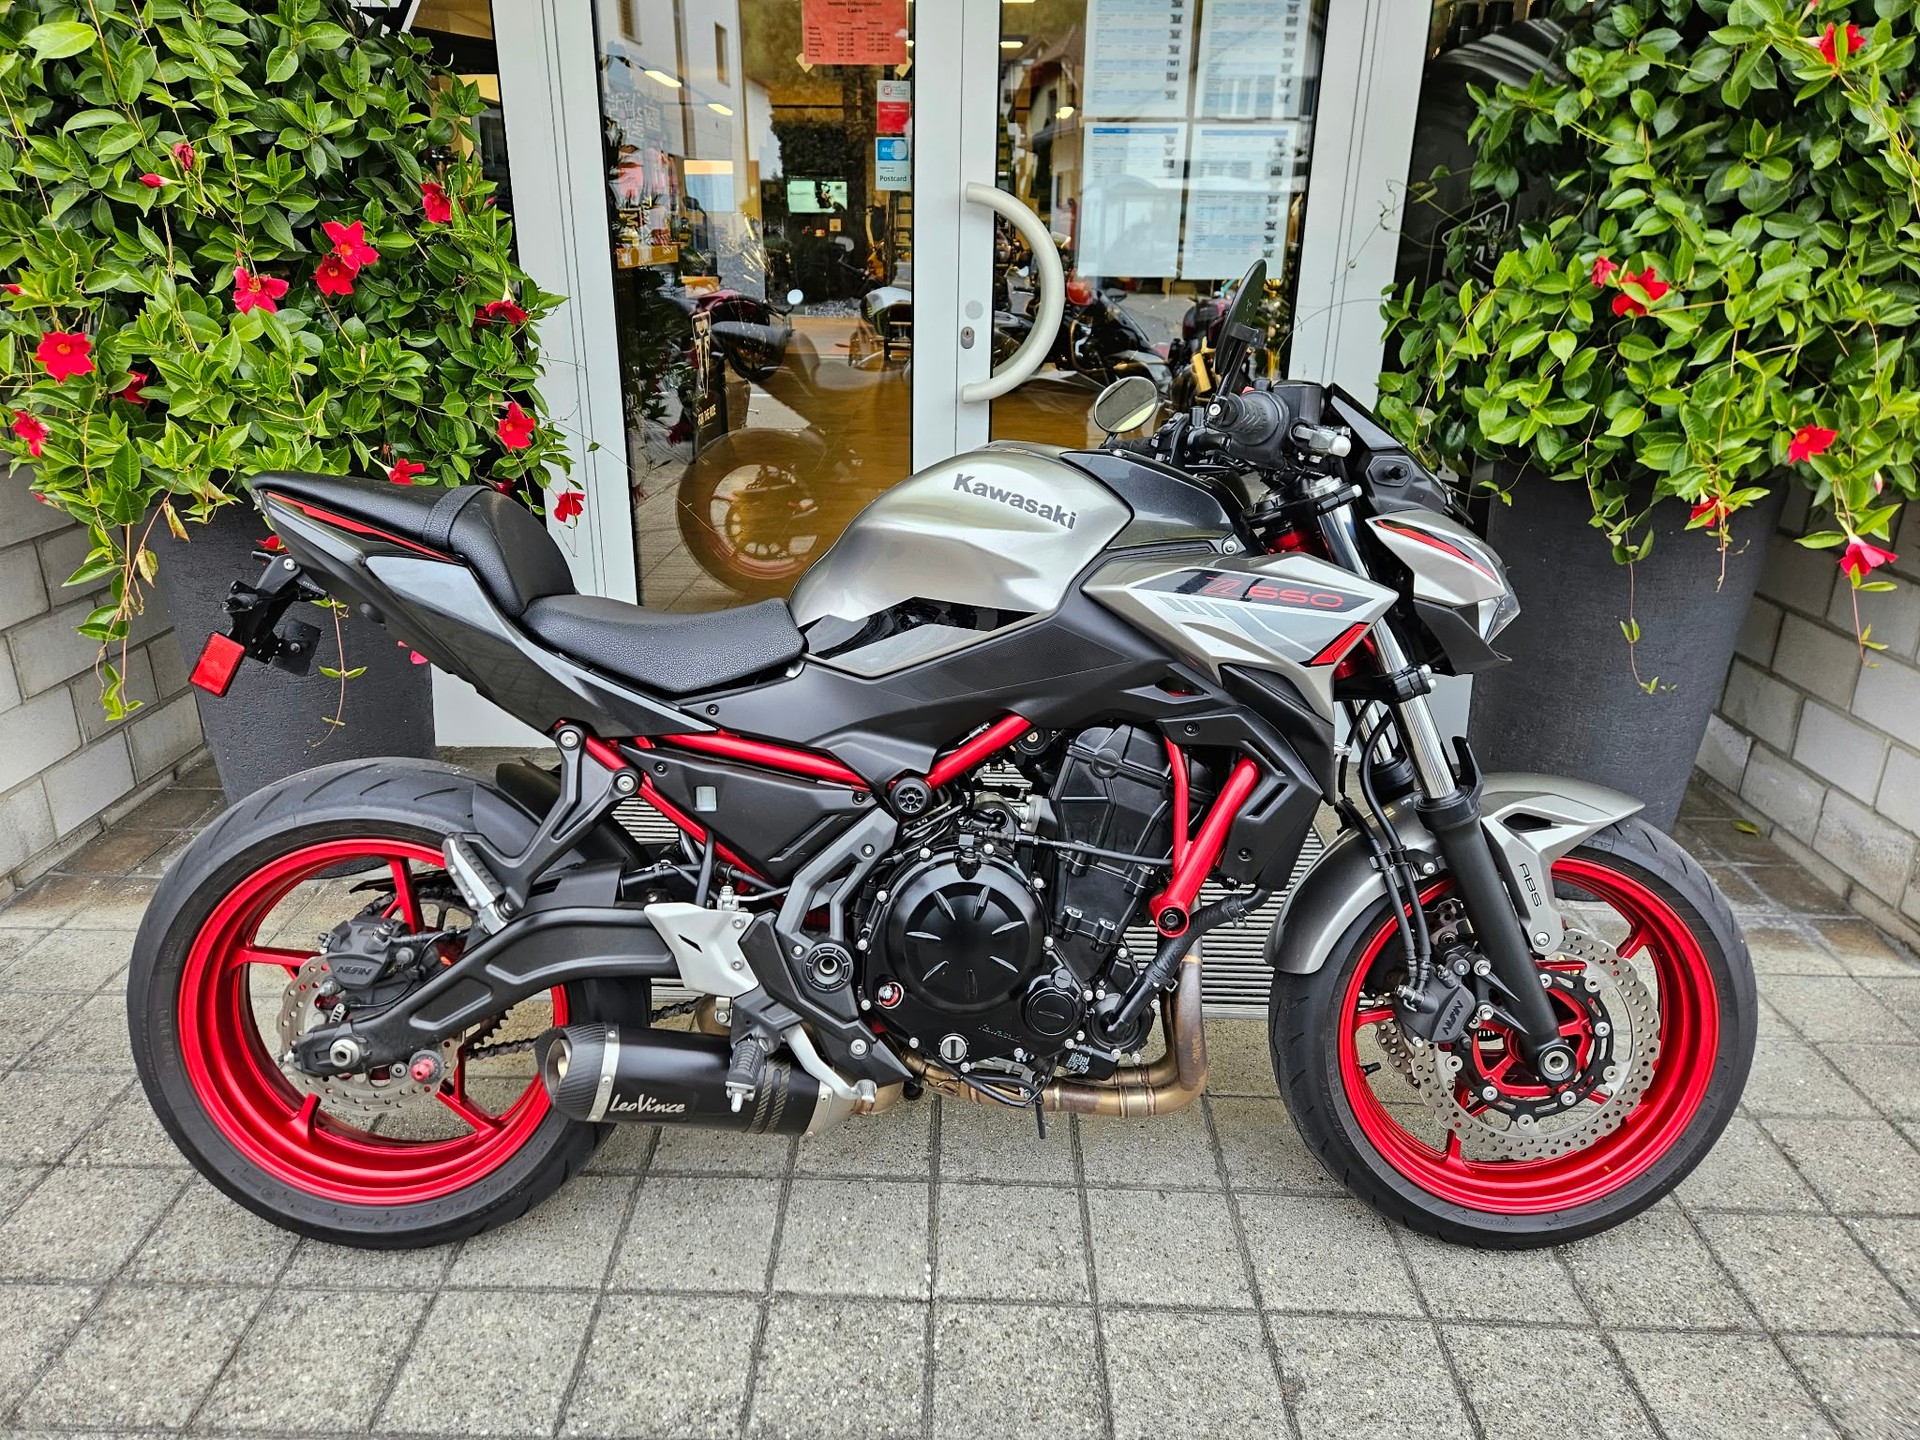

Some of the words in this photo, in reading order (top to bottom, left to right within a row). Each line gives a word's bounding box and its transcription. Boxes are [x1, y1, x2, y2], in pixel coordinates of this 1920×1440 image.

[879, 174, 907, 182] Postcard
[953, 473, 1077, 530] Kawasaki
[1519, 863, 1542, 907] ABS
[609, 1093, 686, 1113] LeoVince
